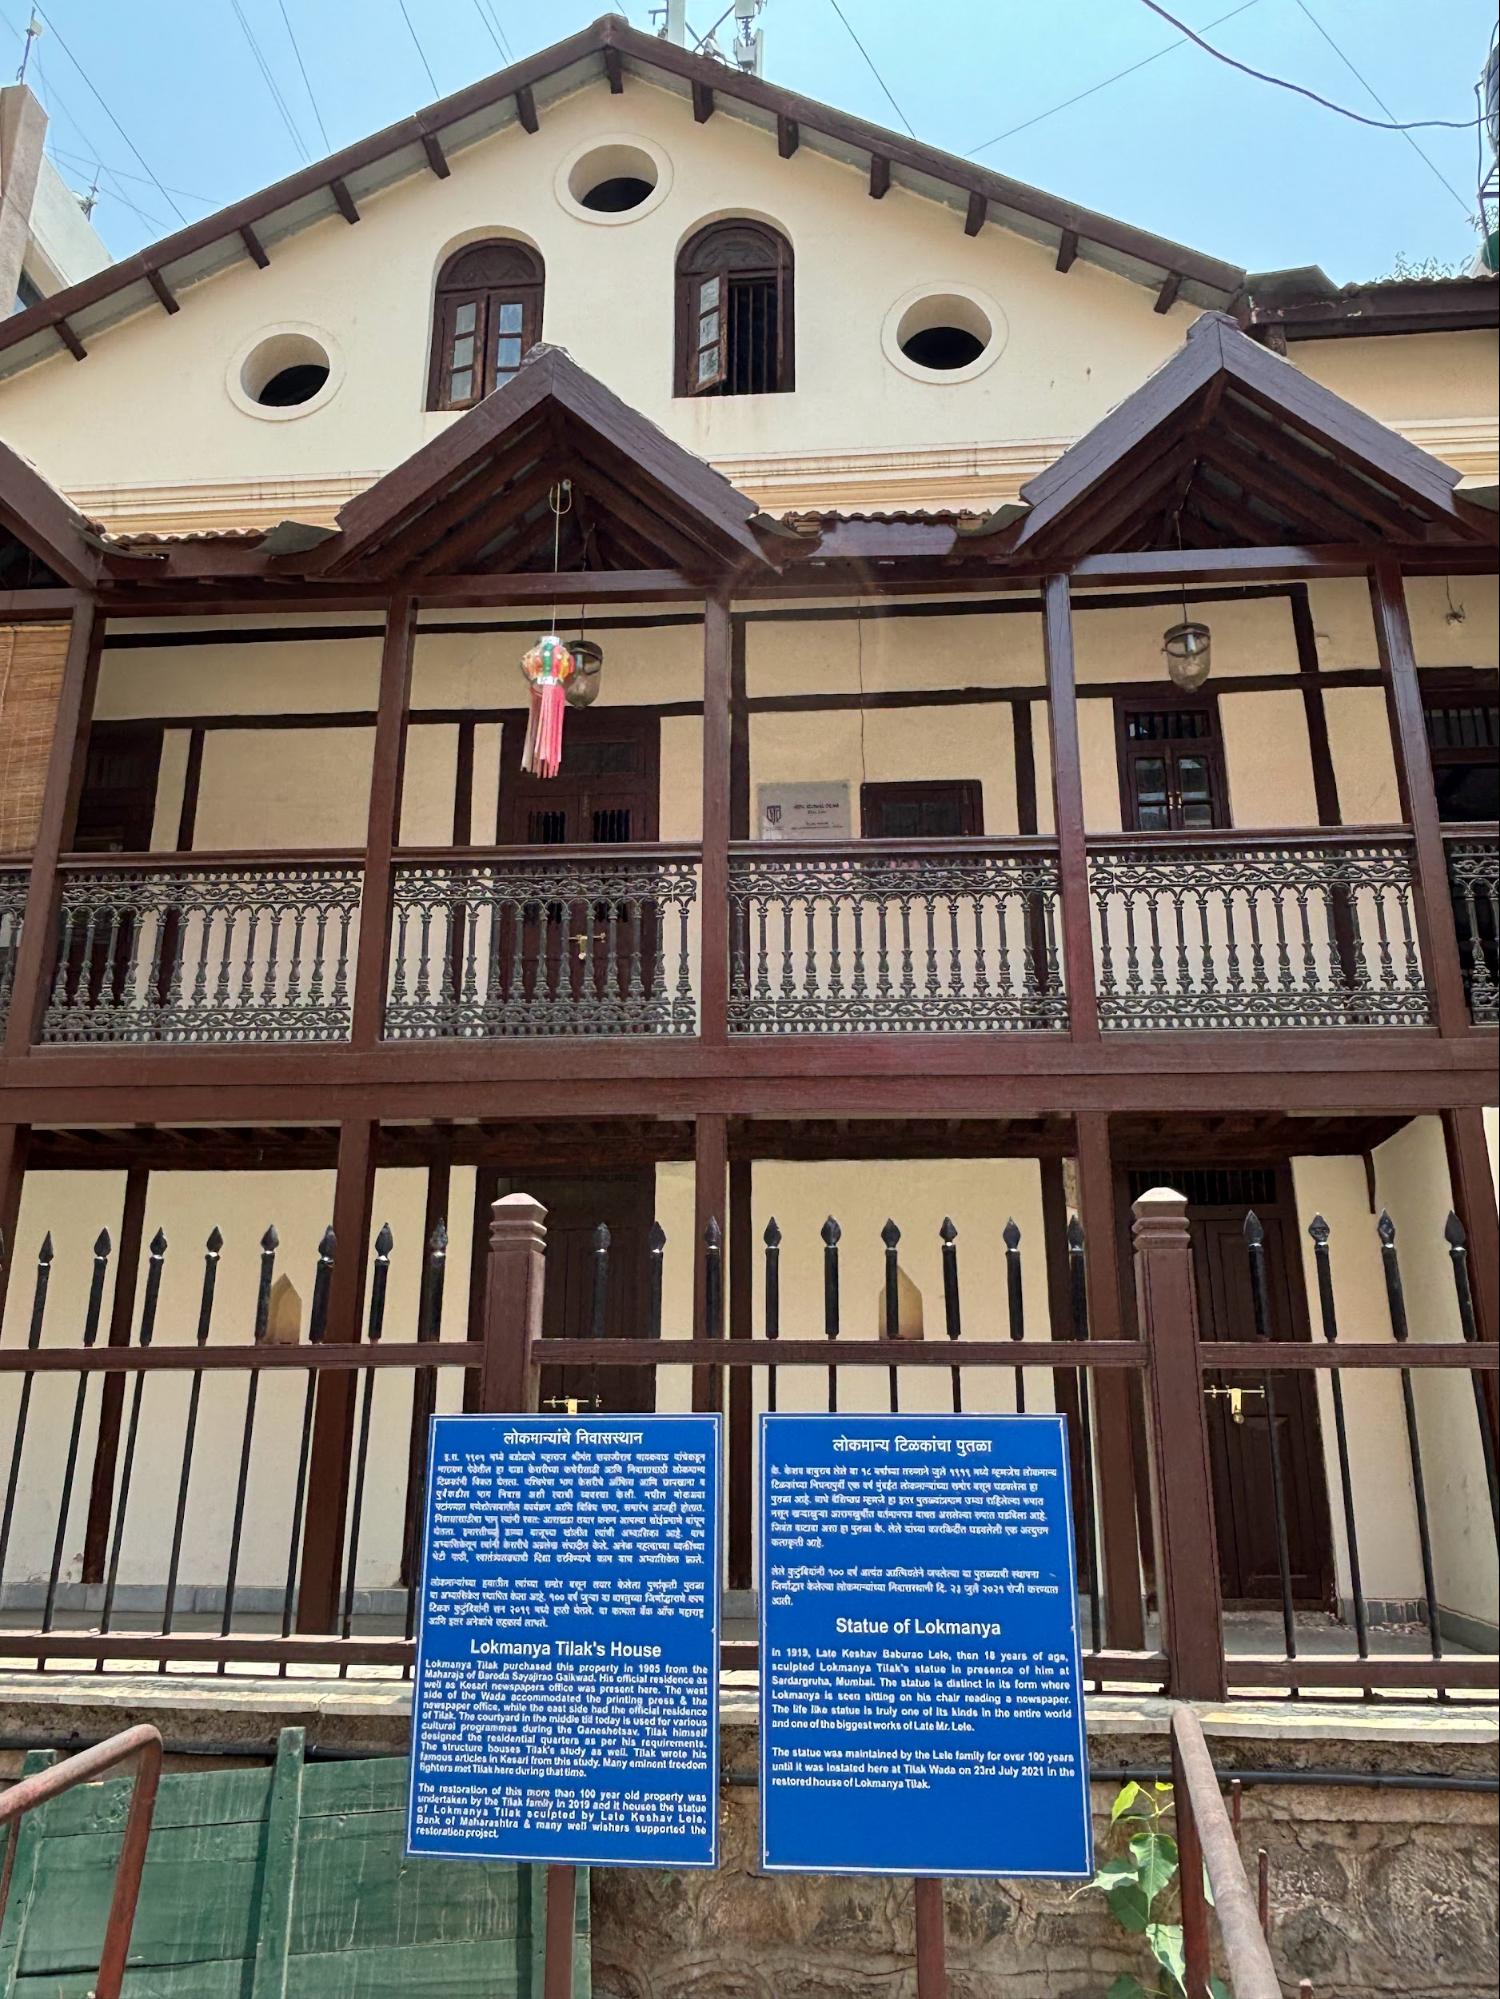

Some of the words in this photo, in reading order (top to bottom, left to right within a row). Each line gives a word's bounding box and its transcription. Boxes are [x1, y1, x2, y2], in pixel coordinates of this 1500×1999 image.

[504, 1428, 571, 1444] लोकमान्यांचे
[576, 1429, 643, 1444] निवासस्थान
[832, 1435, 889, 1452] लोकमान्य
[895, 1436, 951, 1452] टिळकांचा
[956, 1440, 992, 1456] पुतळा
[836, 1618, 888, 1633] Statue
[893, 1618, 910, 1633] of
[914, 1618, 1000, 1637] Lokmanya
[470, 1638, 550, 1658] Lokmanya
[556, 1640, 605, 1656] Tilak's
[610, 1641, 661, 1657] House
[771, 1647, 781, 1656] In
[815, 1648, 836, 1657] Late
[841, 1648, 877, 1658] Keshav
[882, 1649, 923, 1658] Baburao
[956, 1650, 978, 1659] then
[1000, 1653, 1027, 1662] years
[1032, 1651, 1042, 1660] of
[425, 1659, 471, 1671] Lokmanya
[476, 1660, 498, 1669] Tilak
[502, 1661, 552, 1672] purchased
[556, 1662, 574, 1671] this
[579, 1662, 618, 1674] property
[623, 1663, 633, 1672] in
[665, 1664, 688, 1673] from
[692, 1665, 707, 1674] the
[771, 1662, 814, 1673] sculpted
[819, 1662, 871, 1674] Lokmanya
[877, 1663, 909, 1672] Tilak's
[914, 1664, 946, 1673] statue
[951, 1664, 961, 1673] in
[966, 1666, 1013, 1676] presence
[1018, 1665, 1029, 1674] of
[1034, 1665, 1054, 1674] him
[1059, 1666, 1069, 1675] at
[879, 1677, 897, 1686] The
[900, 1678, 930, 1687] statue
[933, 1678, 942, 1687] is
[946, 1678, 982, 1688] distinct
[985, 1679, 995, 1688] in
[998, 1679, 1011, 1688] its
[1014, 1679, 1037, 1688] form
[1040, 1680, 1070, 1689] where
[771, 1690, 820, 1701] Lokmanya
[824, 1691, 833, 1700] is
[864, 1692, 895, 1702] sitting
[916, 1692, 931, 1701] his
[935, 1692, 960, 1701] chair
[964, 1693, 1001, 1704] reading
[772, 1704, 789, 1713] The
[792, 1705, 807, 1714] life
[810, 1705, 828, 1714] like
[830, 1705, 860, 1714] statue
[863, 1705, 872, 1715] is
[875, 1706, 897, 1717] truly
[922, 1706, 932, 1715] of
[935, 1706, 948, 1716] its
[951, 1707, 978, 1716] kinds
[981, 1707, 991, 1716] in
[994, 1707, 1010, 1716] the
[1013, 1708, 1041, 1717] entire
[1044, 1708, 1072, 1717] world
[421, 1721, 456, 1731] cultural
[522, 1723, 552, 1735] during
[556, 1724, 572, 1733] the
[645, 1726, 667, 1735] Tilak
[672, 1727, 707, 1736] himself
[771, 1719, 789, 1728] and
[820, 1719, 835, 1729] the
[836, 1720, 872, 1731] biggest
[872, 1720, 901, 1729] works
[913, 1721, 934, 1730] Late
[772, 1747, 789, 1757] The
[792, 1748, 821, 1757] statue
[823, 1750, 842, 1758] was
[845, 1749, 898, 1758] maintained
[899, 1750, 912, 1761] by
[914, 1750, 930, 1759] the
[932, 1750, 953, 1759] Lele
[955, 1750, 984, 1762] family
[986, 1751, 1001, 1760] for
[1003, 1753, 1024, 1761] over
[1028, 1752, 1045, 1761] 100
[1047, 1754, 1074, 1763] years
[771, 1762, 793, 1771] until
[795, 1762, 802, 1771] it
[804, 1764, 824, 1772] was
[867, 1763, 889, 1773] here
[891, 1764, 901, 1773] at
[904, 1764, 926, 1773] Tilak
[929, 1764, 956, 1774] Wada
[998, 1766, 1018, 1777] July
[1021, 1766, 1043, 1776] 2021
[1047, 1767, 1056, 1776] in
[1059, 1767, 1074, 1776] the
[771, 1776, 812, 1786] restored
[812, 1777, 842, 1787] house
[842, 1777, 853, 1787] of
[854, 1777, 904, 1789] Lokmanya
[418, 1783, 434, 1792] The
[439, 1784, 488, 1794] restoration
[491, 1786, 501, 1795] of
[505, 1786, 522, 1795] this
[554, 1788, 575, 1797] than
[580, 1789, 595, 1798] 100
[600, 1791, 620, 1800] year
[624, 1790, 640, 1799] old
[643, 1791, 683, 1802] property
